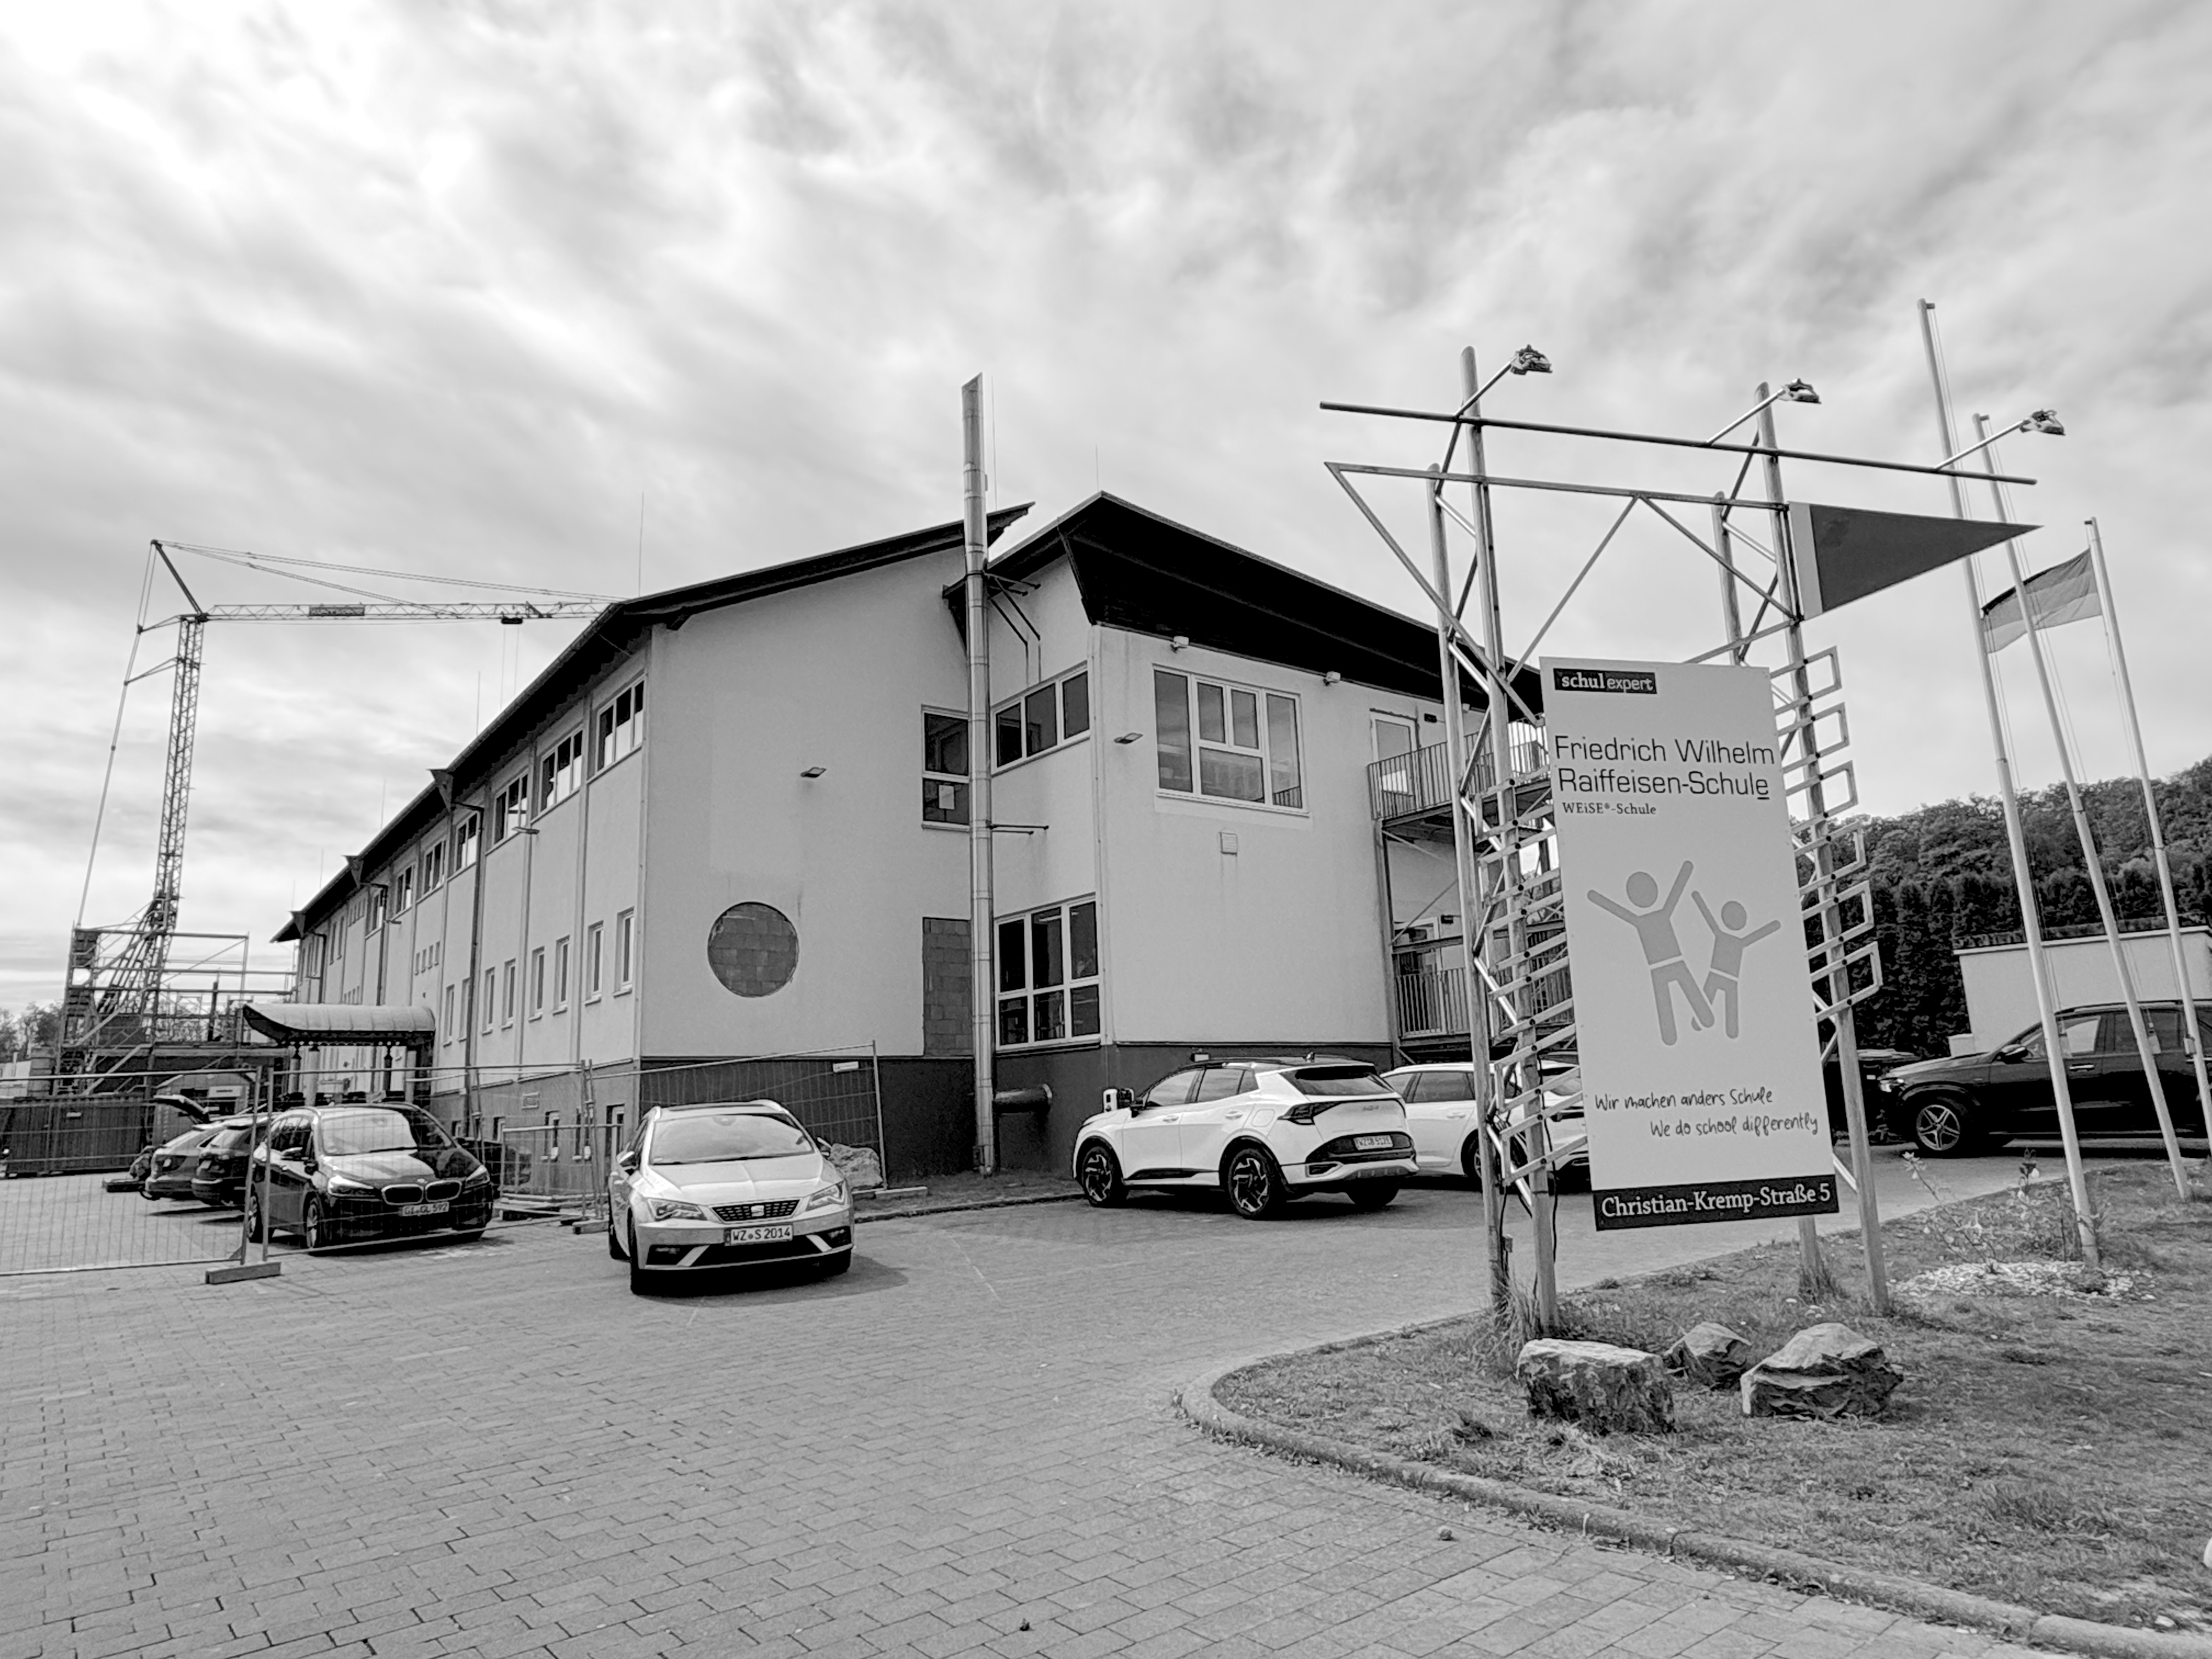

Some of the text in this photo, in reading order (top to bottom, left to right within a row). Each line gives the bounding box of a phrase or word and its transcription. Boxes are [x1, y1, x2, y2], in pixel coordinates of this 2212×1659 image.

[1555, 735, 1775, 764] Friedrich Wilhelm
[1558, 768, 1770, 799] Raiffeisen-Schule
[1594, 1086, 1773, 1111] Wir machen anders Schule
[1650, 1111, 1818, 1137] We do school differently
[1601, 1183, 1831, 1217] Christian-Kremp-Straße 5
[733, 1227, 791, 1241] WZ S 2014
